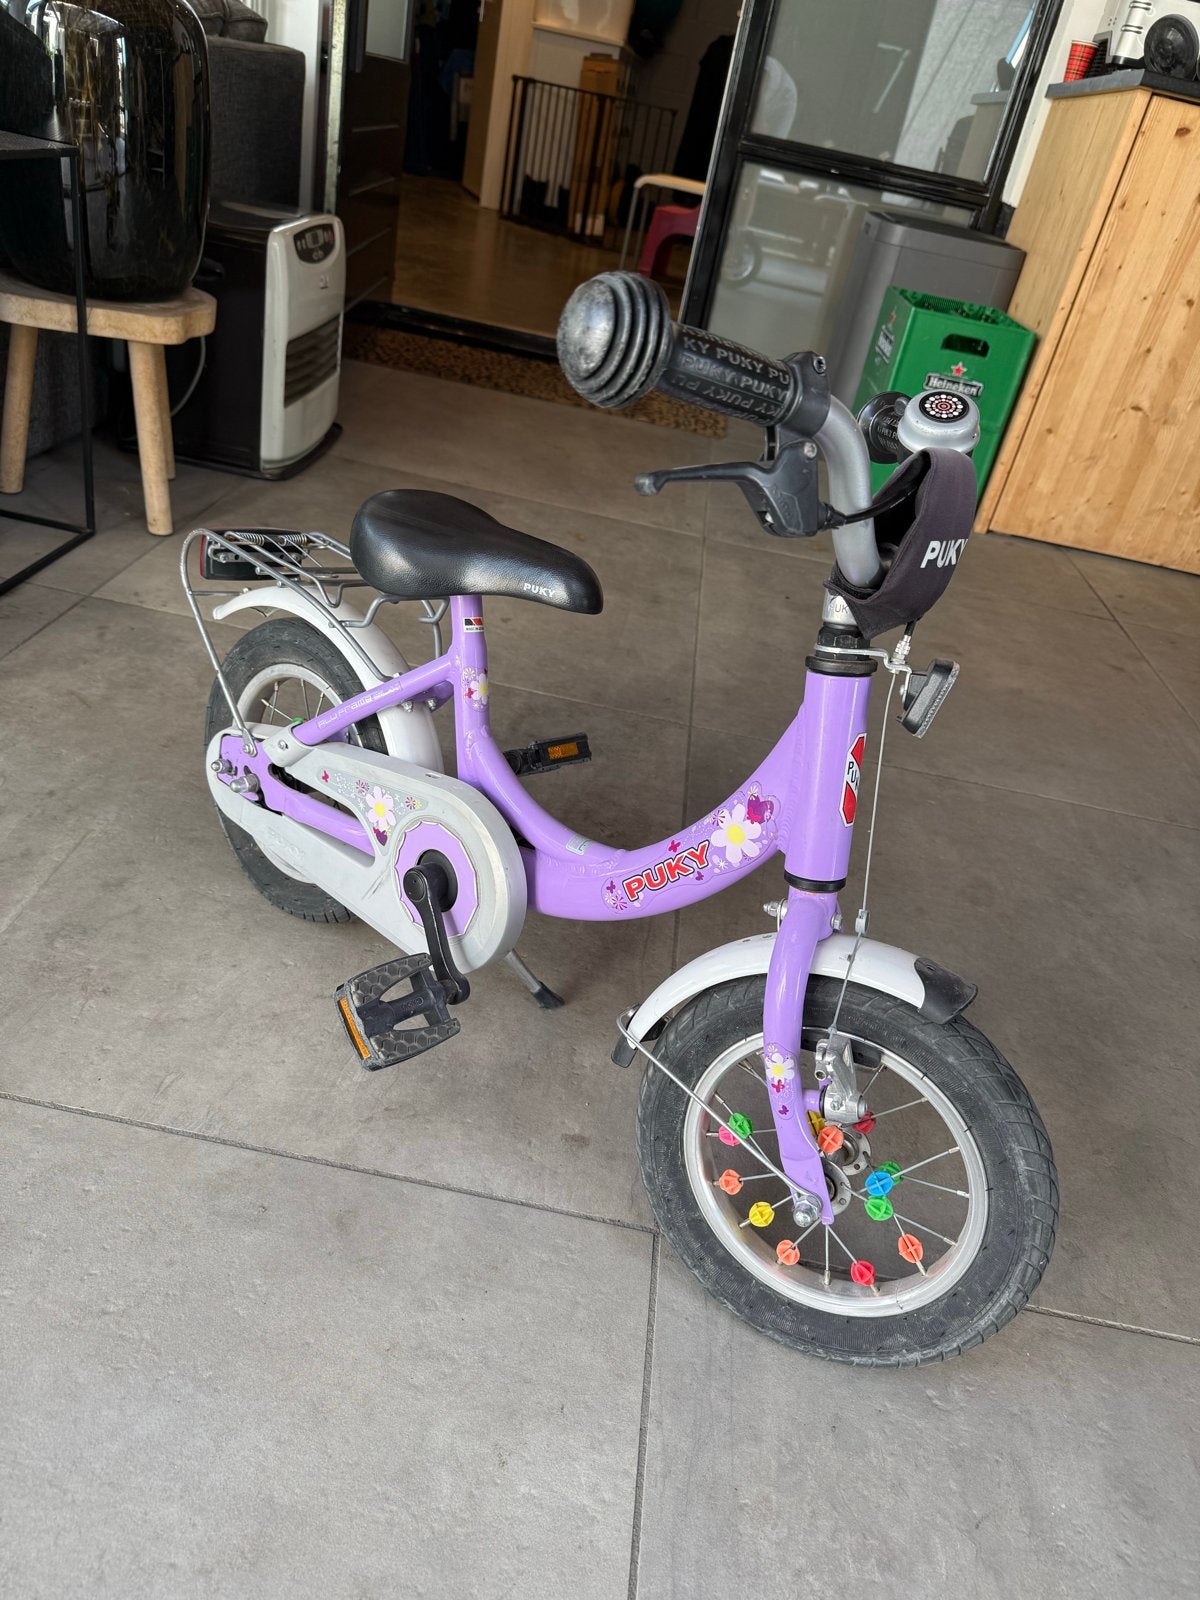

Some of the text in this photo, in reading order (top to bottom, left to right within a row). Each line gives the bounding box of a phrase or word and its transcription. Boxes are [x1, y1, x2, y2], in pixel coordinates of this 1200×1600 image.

[716, 347, 764, 374] PUKY
[703, 386, 754, 409] PUKY
[739, 377, 789, 401] PUKY
[927, 375, 978, 397] Heineken
[920, 538, 969, 569] PUKY
[523, 582, 556, 598] PUKY
[622, 839, 710, 903] PUKY
